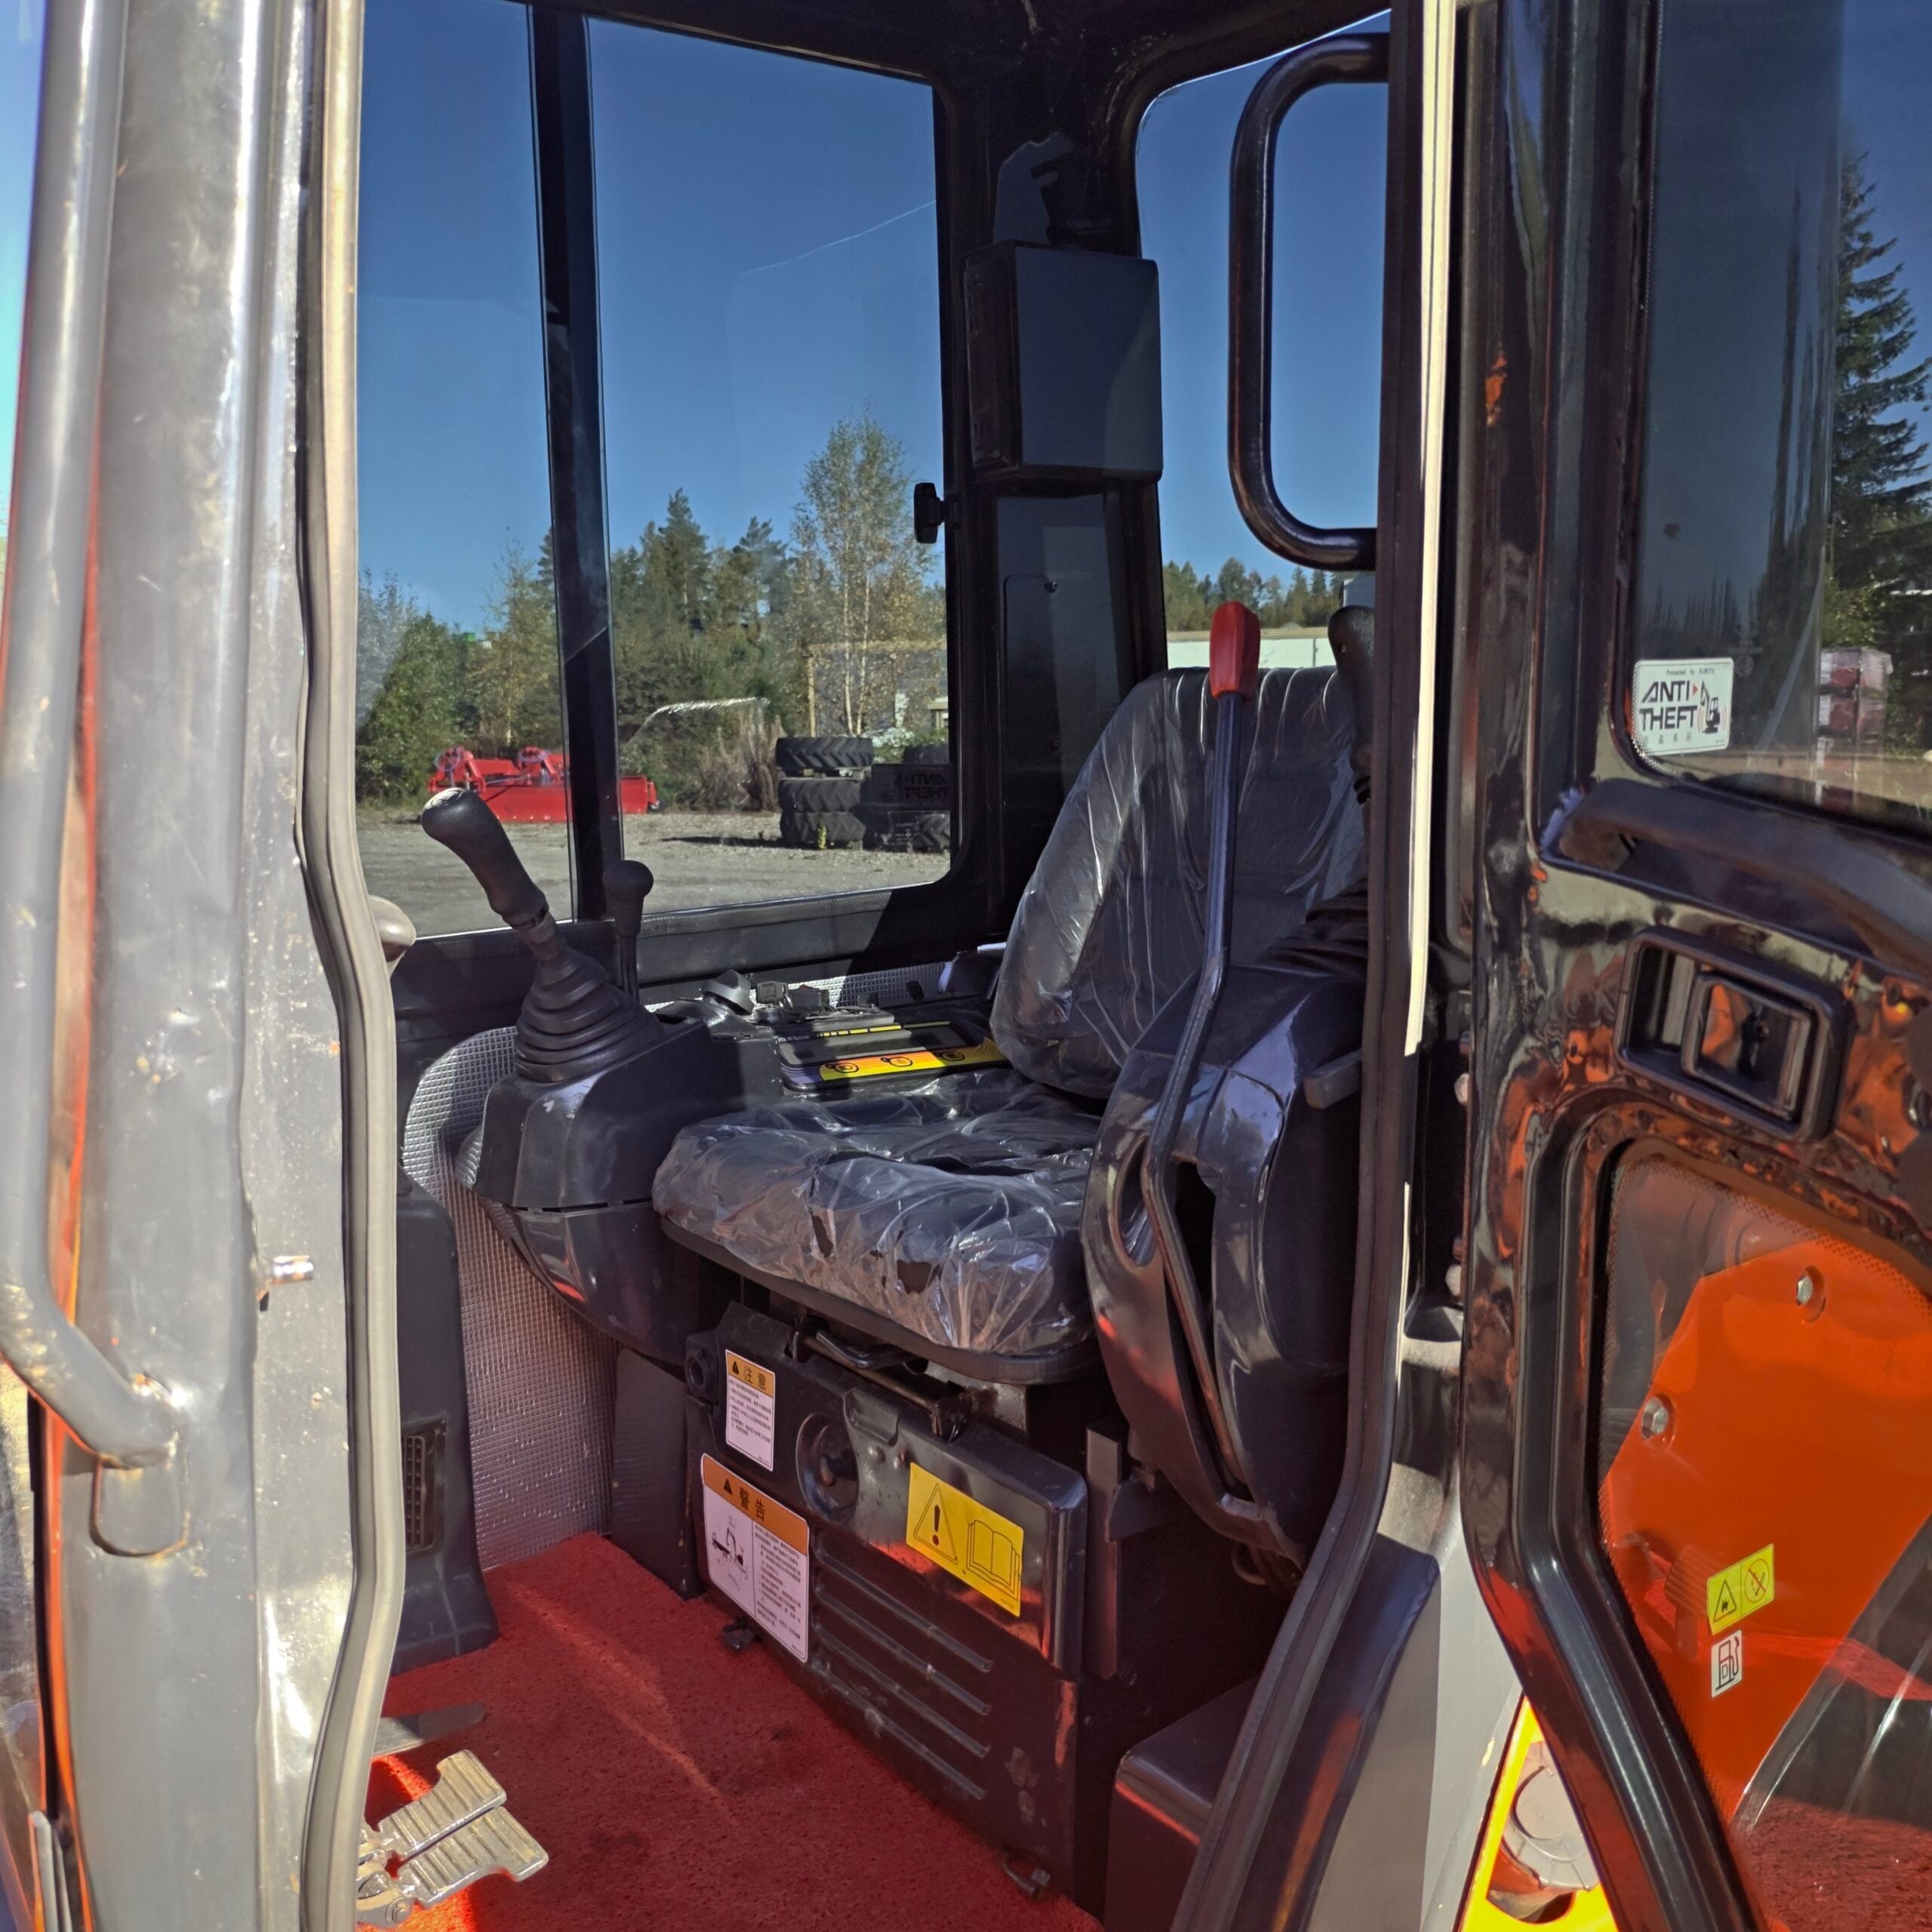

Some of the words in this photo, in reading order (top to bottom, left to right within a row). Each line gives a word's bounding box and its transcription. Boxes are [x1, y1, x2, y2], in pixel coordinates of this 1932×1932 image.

[1641, 680, 1690, 703] ANTI
[1639, 705, 1698, 731] THEFT
[743, 1364, 767, 1390] 注意
[739, 1486, 765, 1521] 警告
